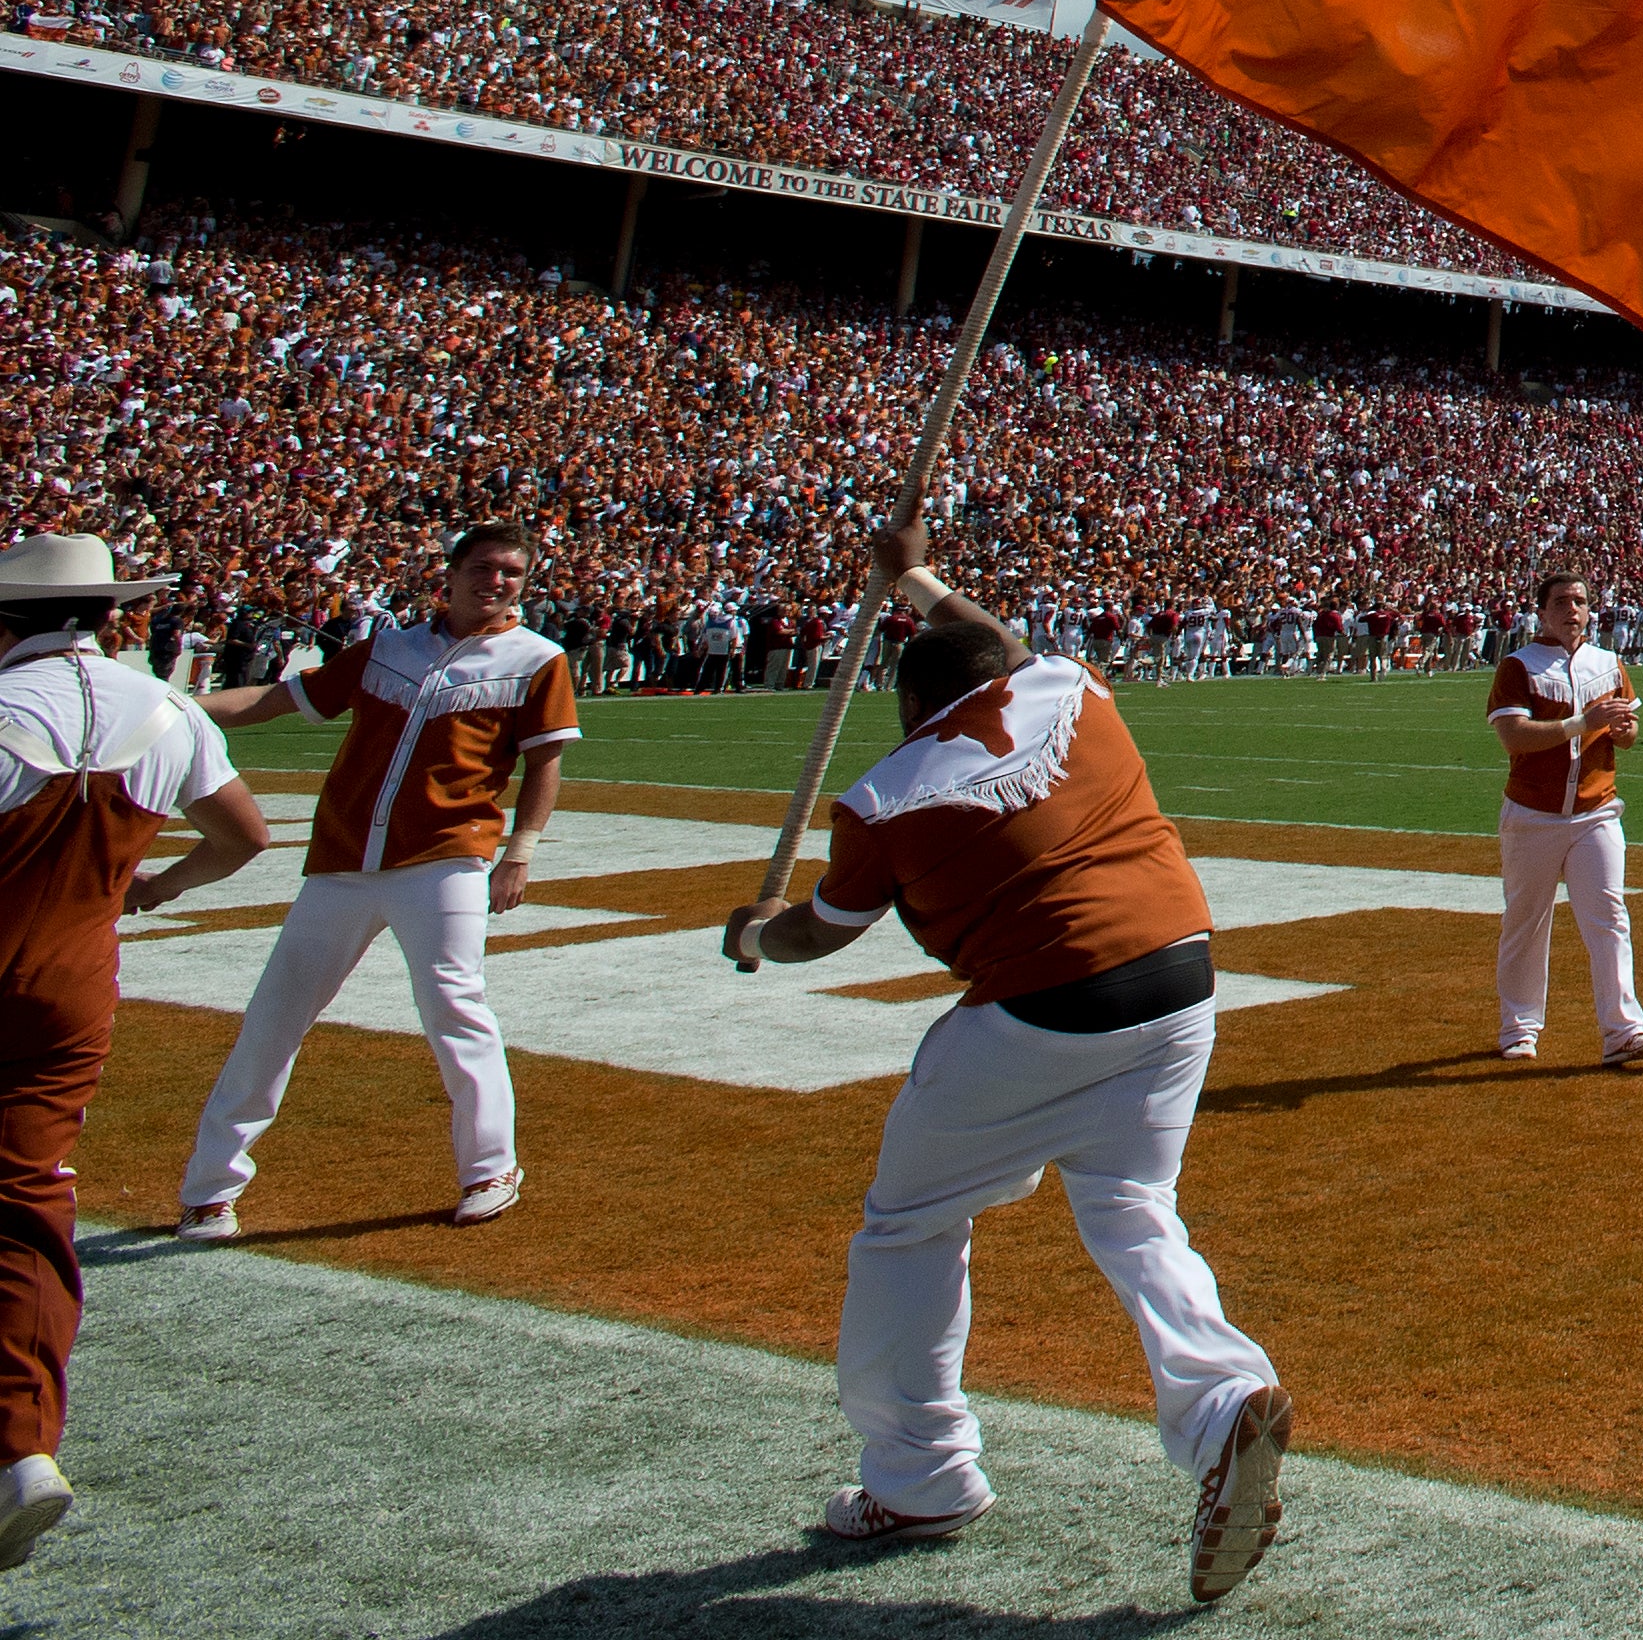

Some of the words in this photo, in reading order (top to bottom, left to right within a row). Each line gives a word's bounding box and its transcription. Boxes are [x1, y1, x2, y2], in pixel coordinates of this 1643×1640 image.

[621, 144, 773, 189] WELCOME
[780, 172, 808, 193] TO
[814, 178, 856, 200] THE
[861, 184, 939, 218] STATE
[945, 197, 1002, 224] FAIR
[1037, 212, 1113, 241] TEXAS
